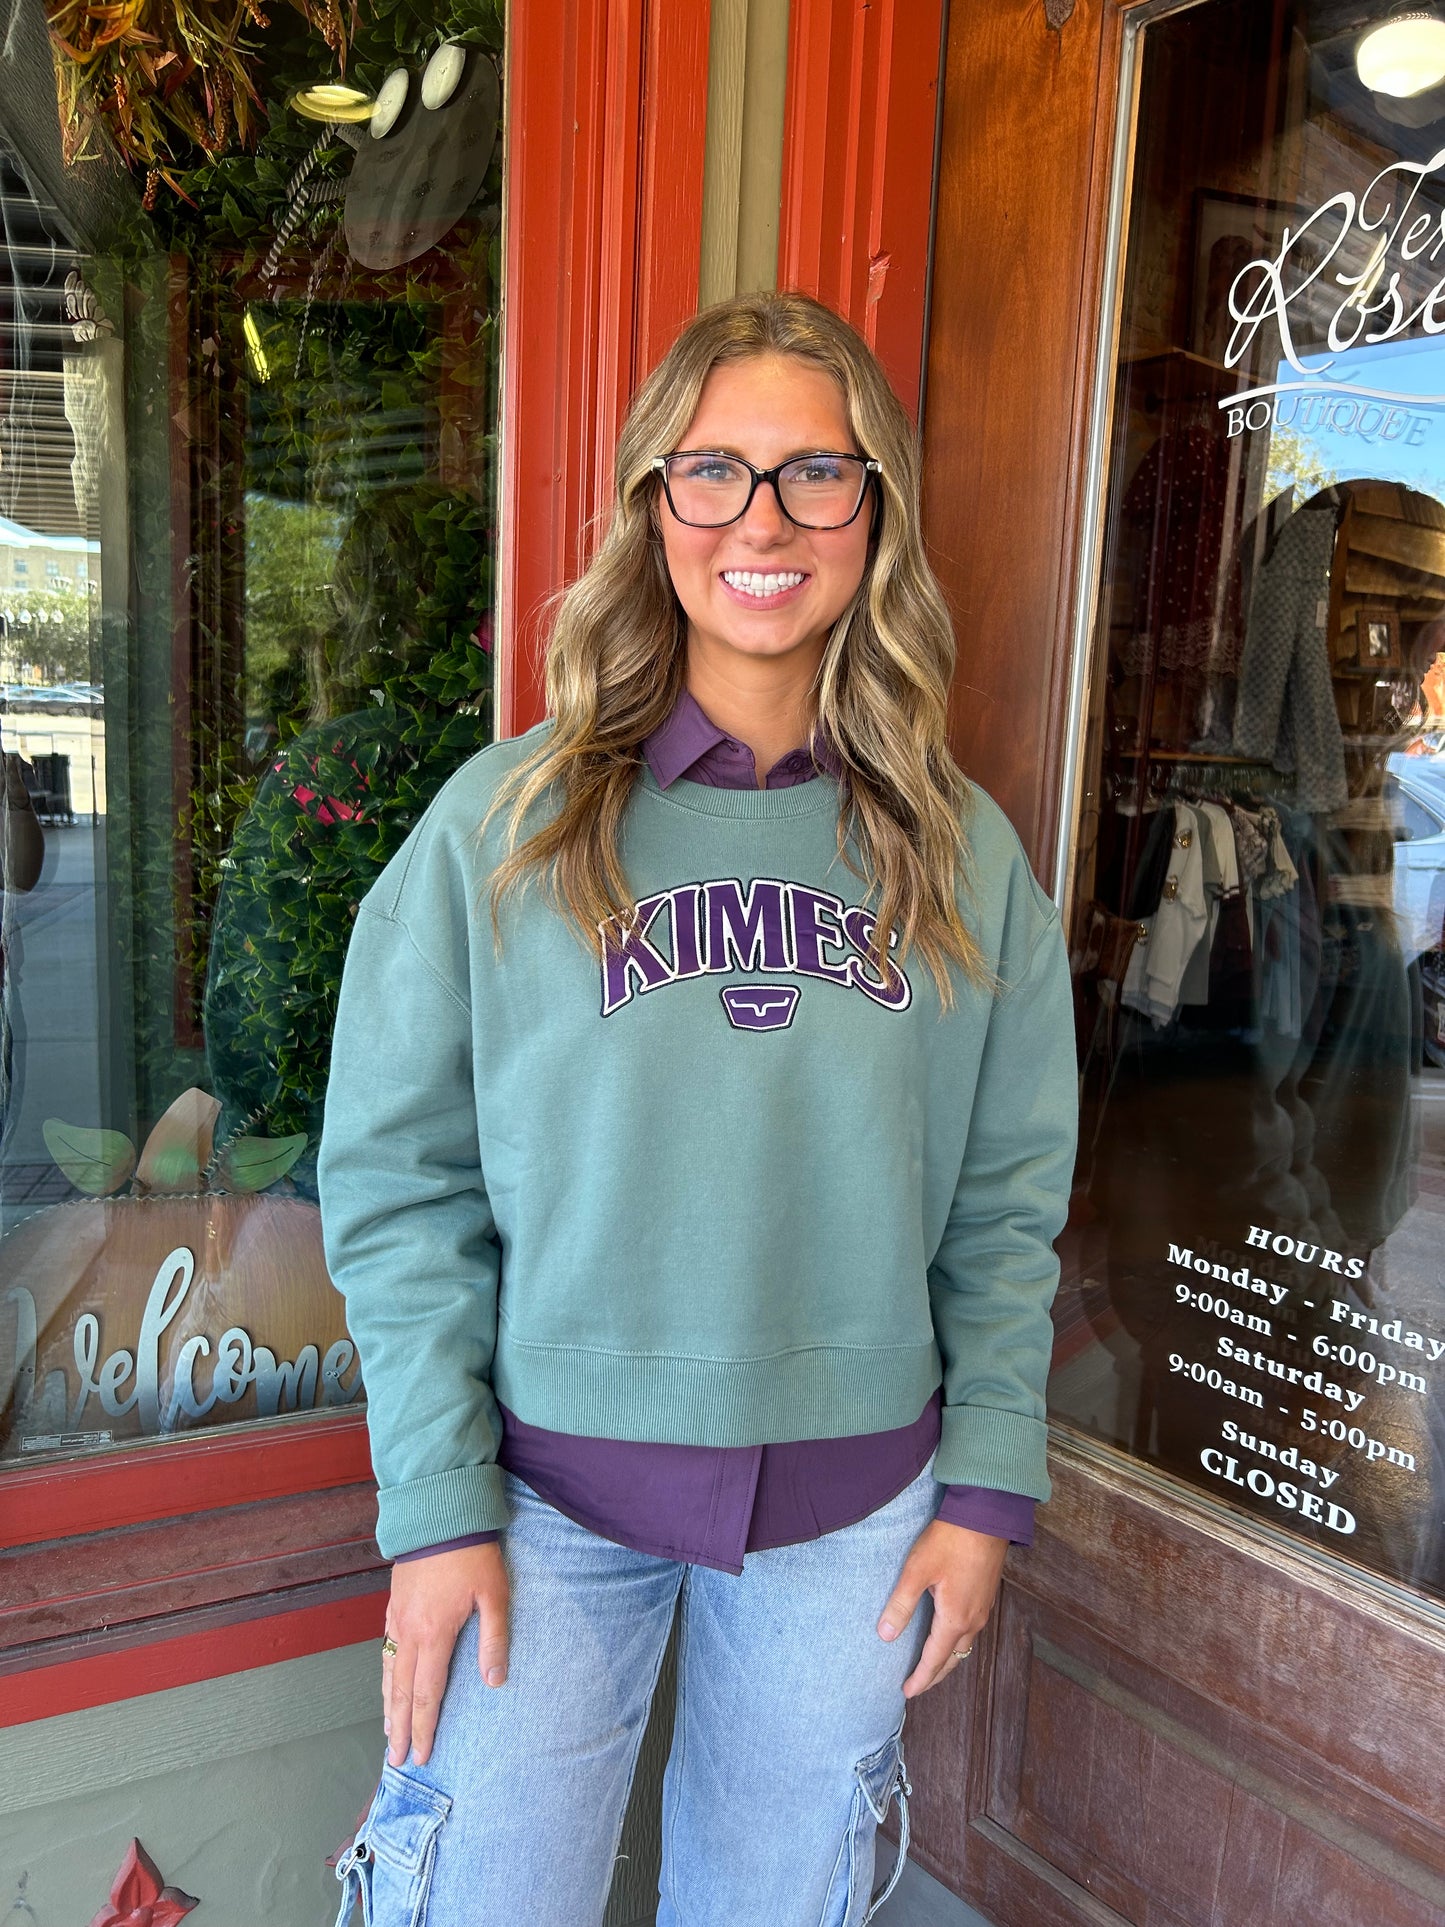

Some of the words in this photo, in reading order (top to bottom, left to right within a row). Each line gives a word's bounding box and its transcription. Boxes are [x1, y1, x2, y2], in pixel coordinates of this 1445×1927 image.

[1226, 396, 1408, 439] BOUTIQUE
[599, 878, 912, 1018] KIMES
[1244, 1225, 1366, 1280] HOURS
[1166, 1243, 1290, 1306] Monday
[1329, 1299, 1445, 1362] Friday
[1174, 1283, 1273, 1338] 9:00am
[1312, 1335, 1428, 1395] 6:00pm
[1168, 1353, 1264, 1410] 9:00am
[1299, 1408, 1417, 1473] 5:00pm
[1216, 1336, 1367, 1412] Saturday
[1199, 1447, 1358, 1535] CLOSED
[1220, 1420, 1341, 1489] Sunday
